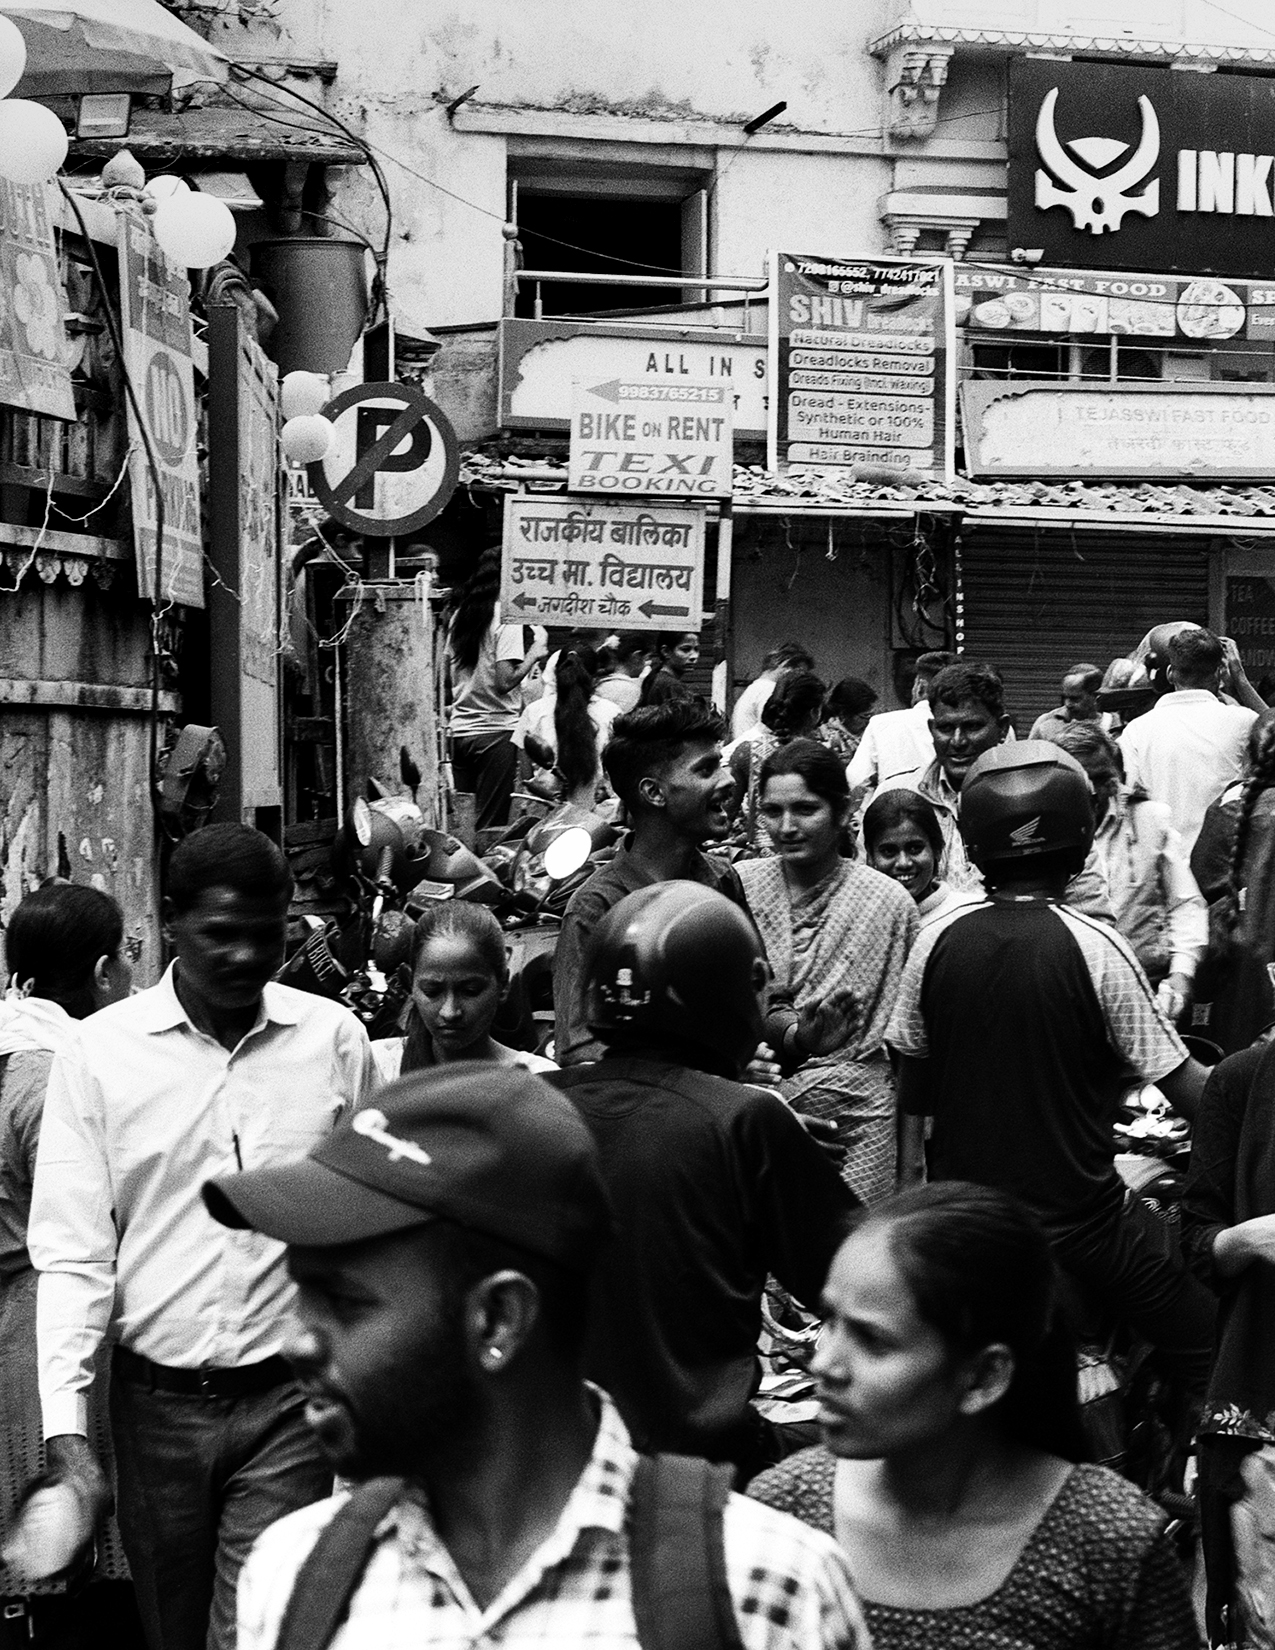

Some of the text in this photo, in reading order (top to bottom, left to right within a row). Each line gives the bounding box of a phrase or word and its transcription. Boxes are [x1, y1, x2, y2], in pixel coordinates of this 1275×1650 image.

[955, 273, 1167, 298] ASWI FAST FOOD
[789, 294, 865, 329] SHIV
[793, 332, 930, 351] Natural Dreadlocks
[646, 352, 690, 376] ALL
[710, 355, 733, 378] IN
[793, 352, 930, 372] Dreadlocks Removal
[792, 372, 829, 386] Dreads
[618, 384, 719, 402] 9983765215
[791, 395, 835, 409] Dread
[797, 411, 924, 429] Synthetic or 100%
[1172, 409, 1215, 424] FAST
[1221, 410, 1271, 425] FOOD
[578, 412, 725, 443] BIKE ON RENT
[819, 427, 903, 443] Human Hair
[579, 450, 719, 477] TEXI
[809, 448, 911, 466] Hair Brainding
[575, 475, 718, 495] BOOKING
[610, 513, 693, 548] बालिका
[511, 552, 695, 592] उच्च मा. विद्यालय
[1230, 584, 1254, 603] TEA
[537, 592, 632, 617] जगदीश चौक
